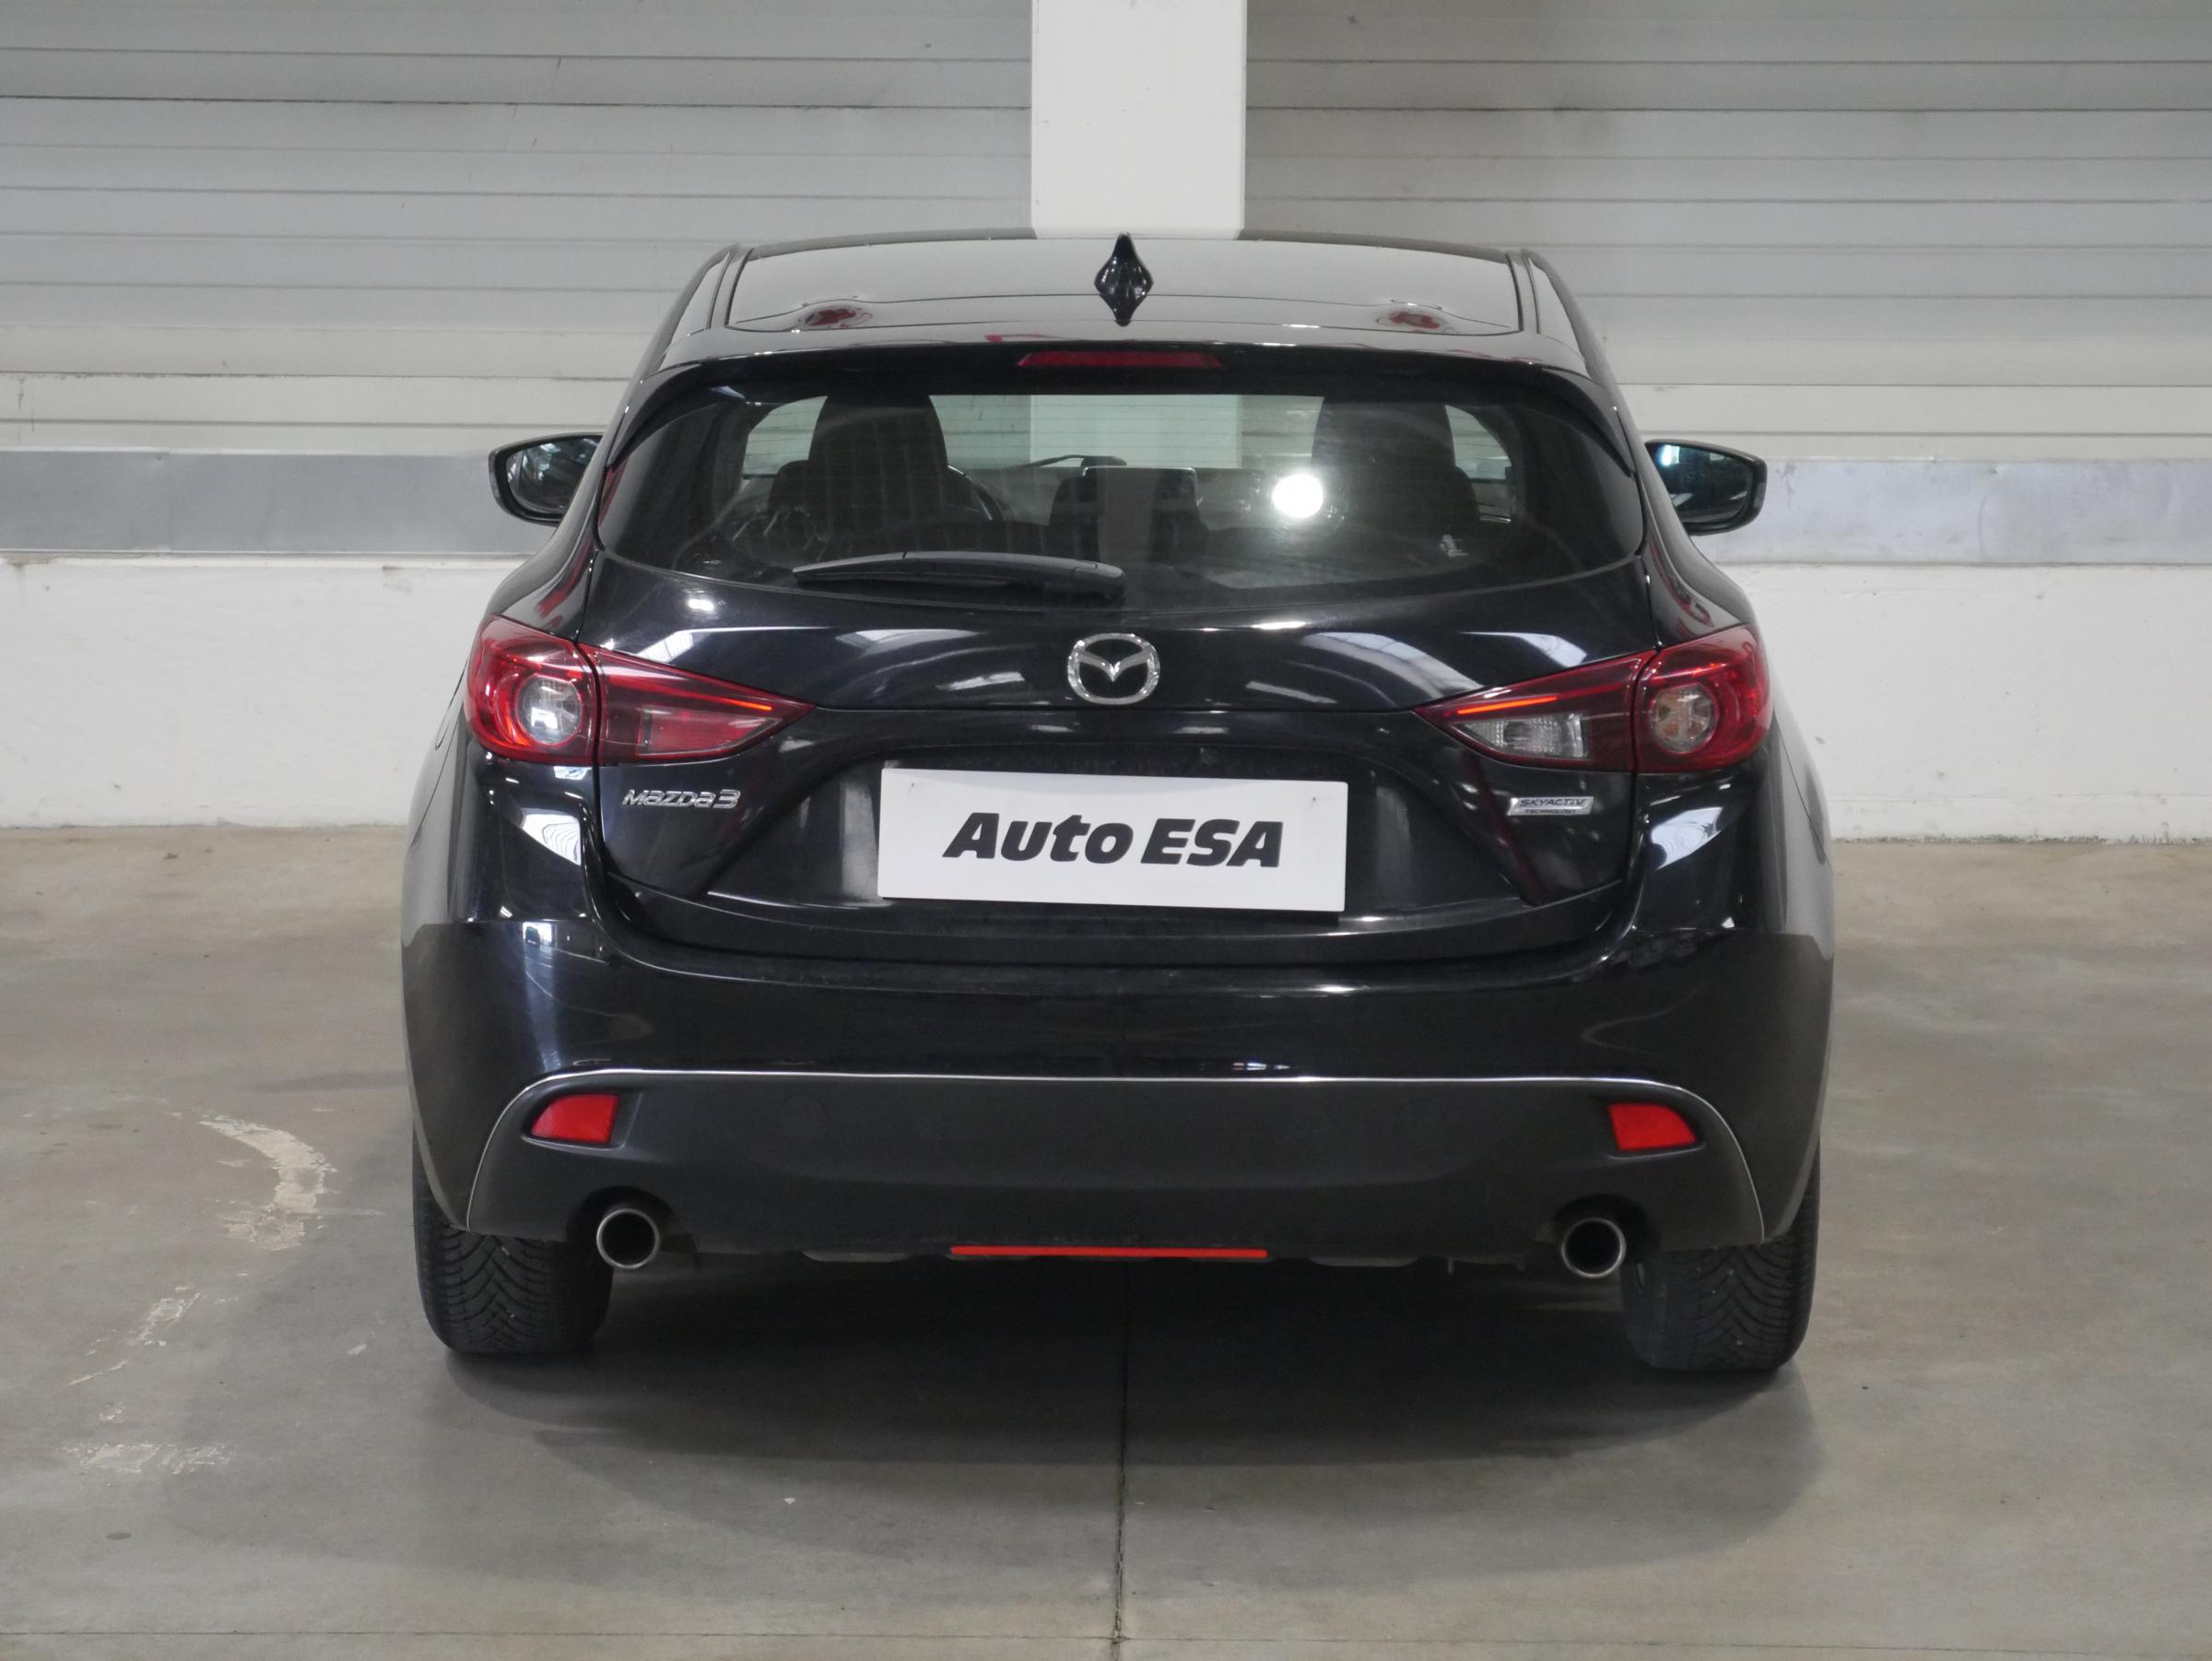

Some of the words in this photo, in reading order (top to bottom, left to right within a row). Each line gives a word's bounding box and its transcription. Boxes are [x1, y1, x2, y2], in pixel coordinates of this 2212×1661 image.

[1519, 798, 1586, 807] SKYACTIV
[942, 812, 1135, 865] Auto
[1140, 818, 1284, 868] ESA
